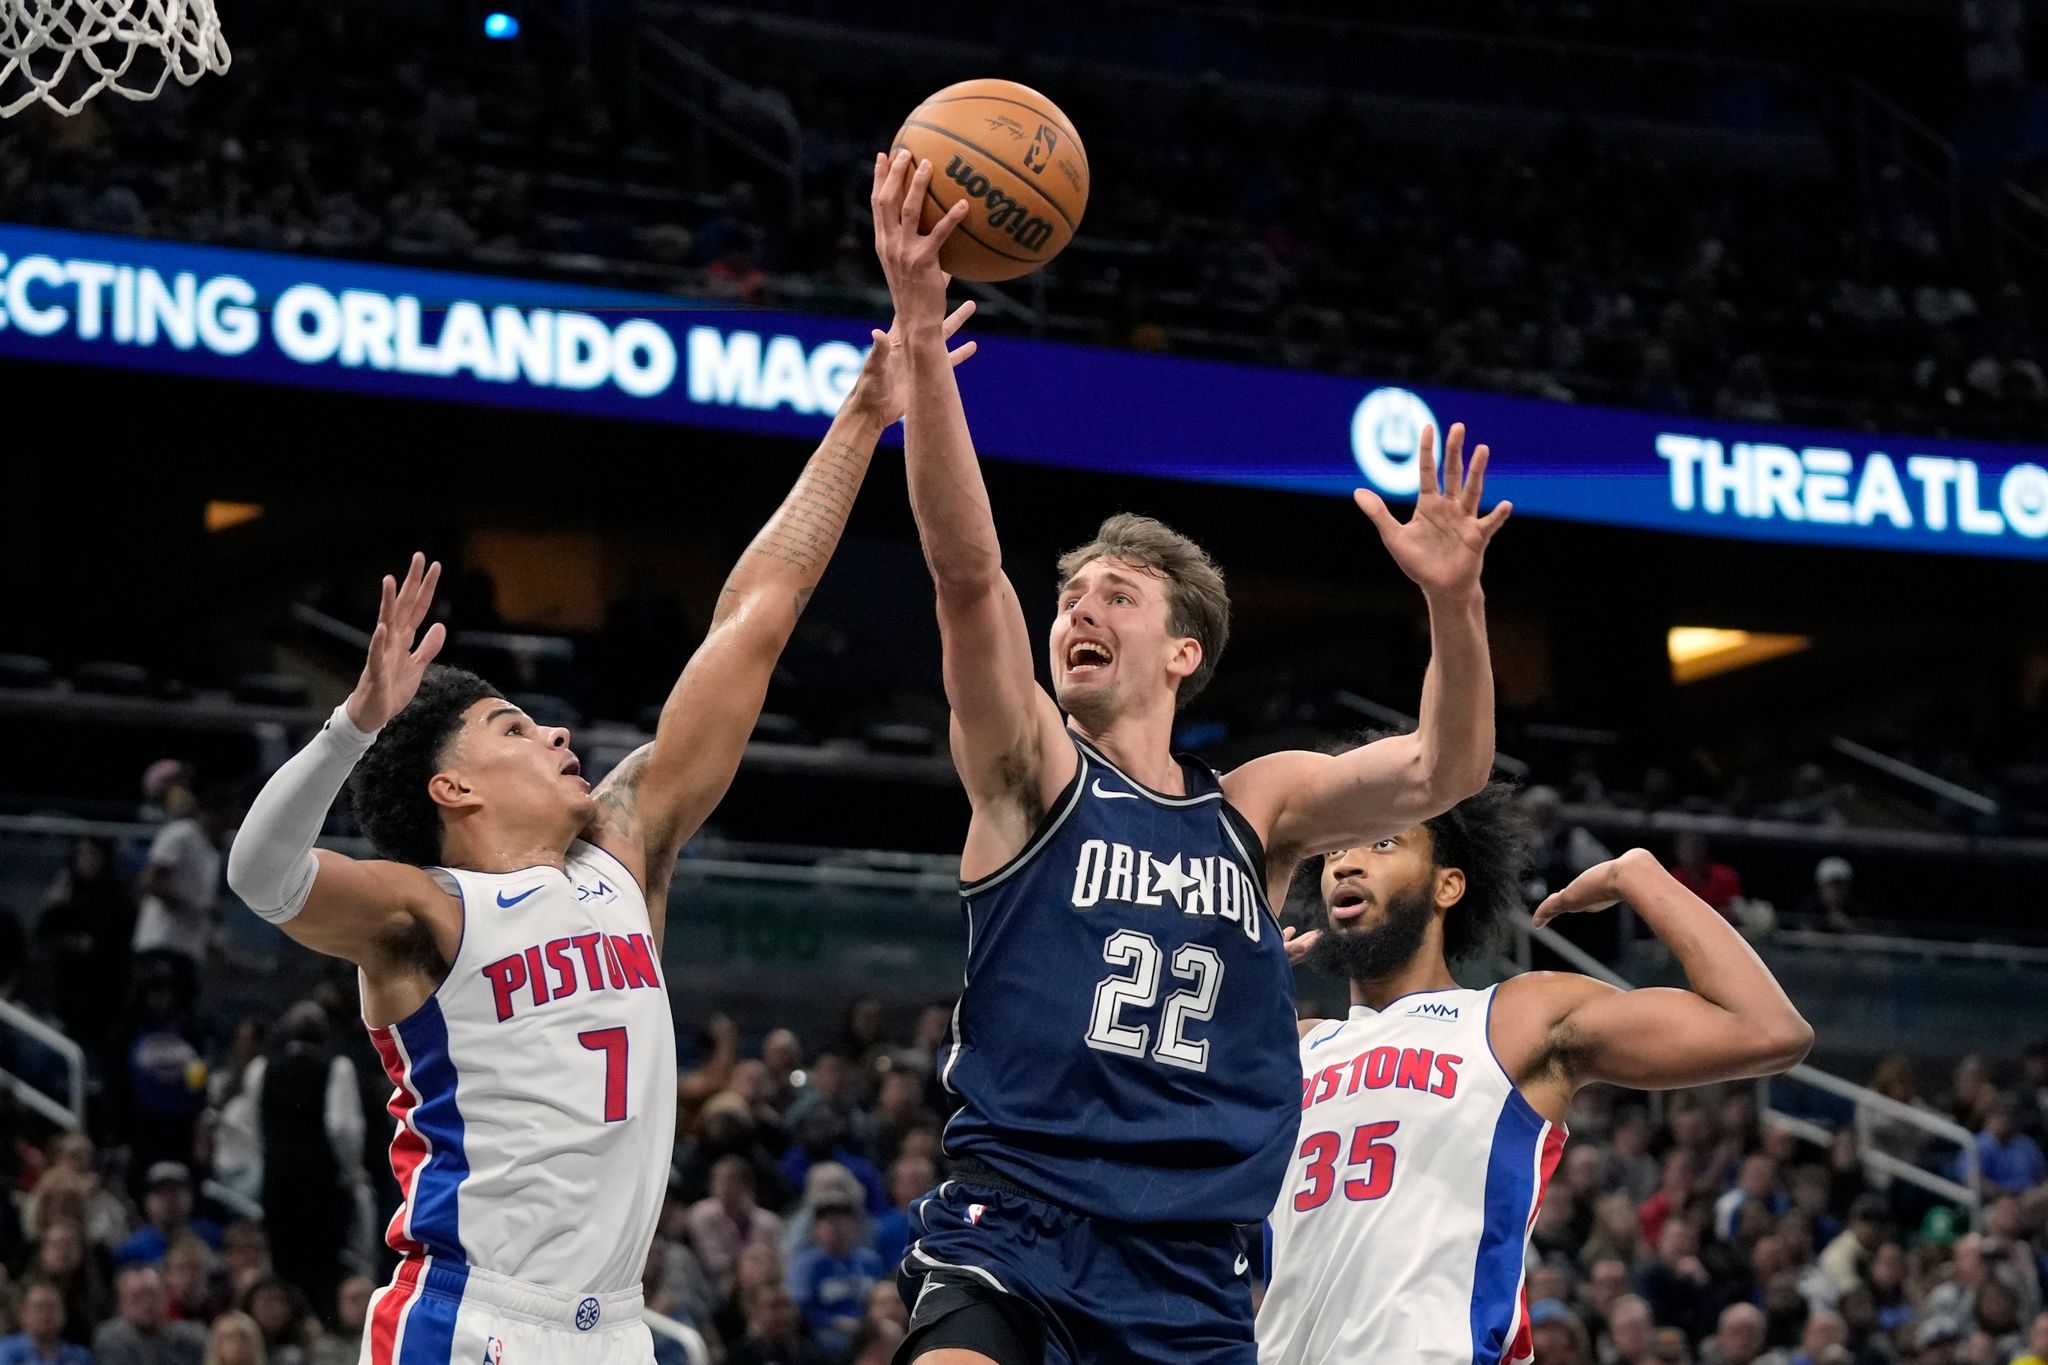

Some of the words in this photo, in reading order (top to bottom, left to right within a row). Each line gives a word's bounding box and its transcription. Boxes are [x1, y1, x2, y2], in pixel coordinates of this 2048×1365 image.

[945, 153, 1054, 253] Wilson
[0, 252, 260, 357] CTING
[272, 282, 678, 398] ORLANDO
[686, 324, 872, 417] MAG
[482, 931, 661, 1023] PISTON
[1084, 928, 1226, 1073] 22
[1407, 1003, 1459, 1018] JWM
[577, 1026, 630, 1123] 7
[1301, 1046, 1464, 1111] ISTONS
[1294, 1120, 1400, 1213] 35
